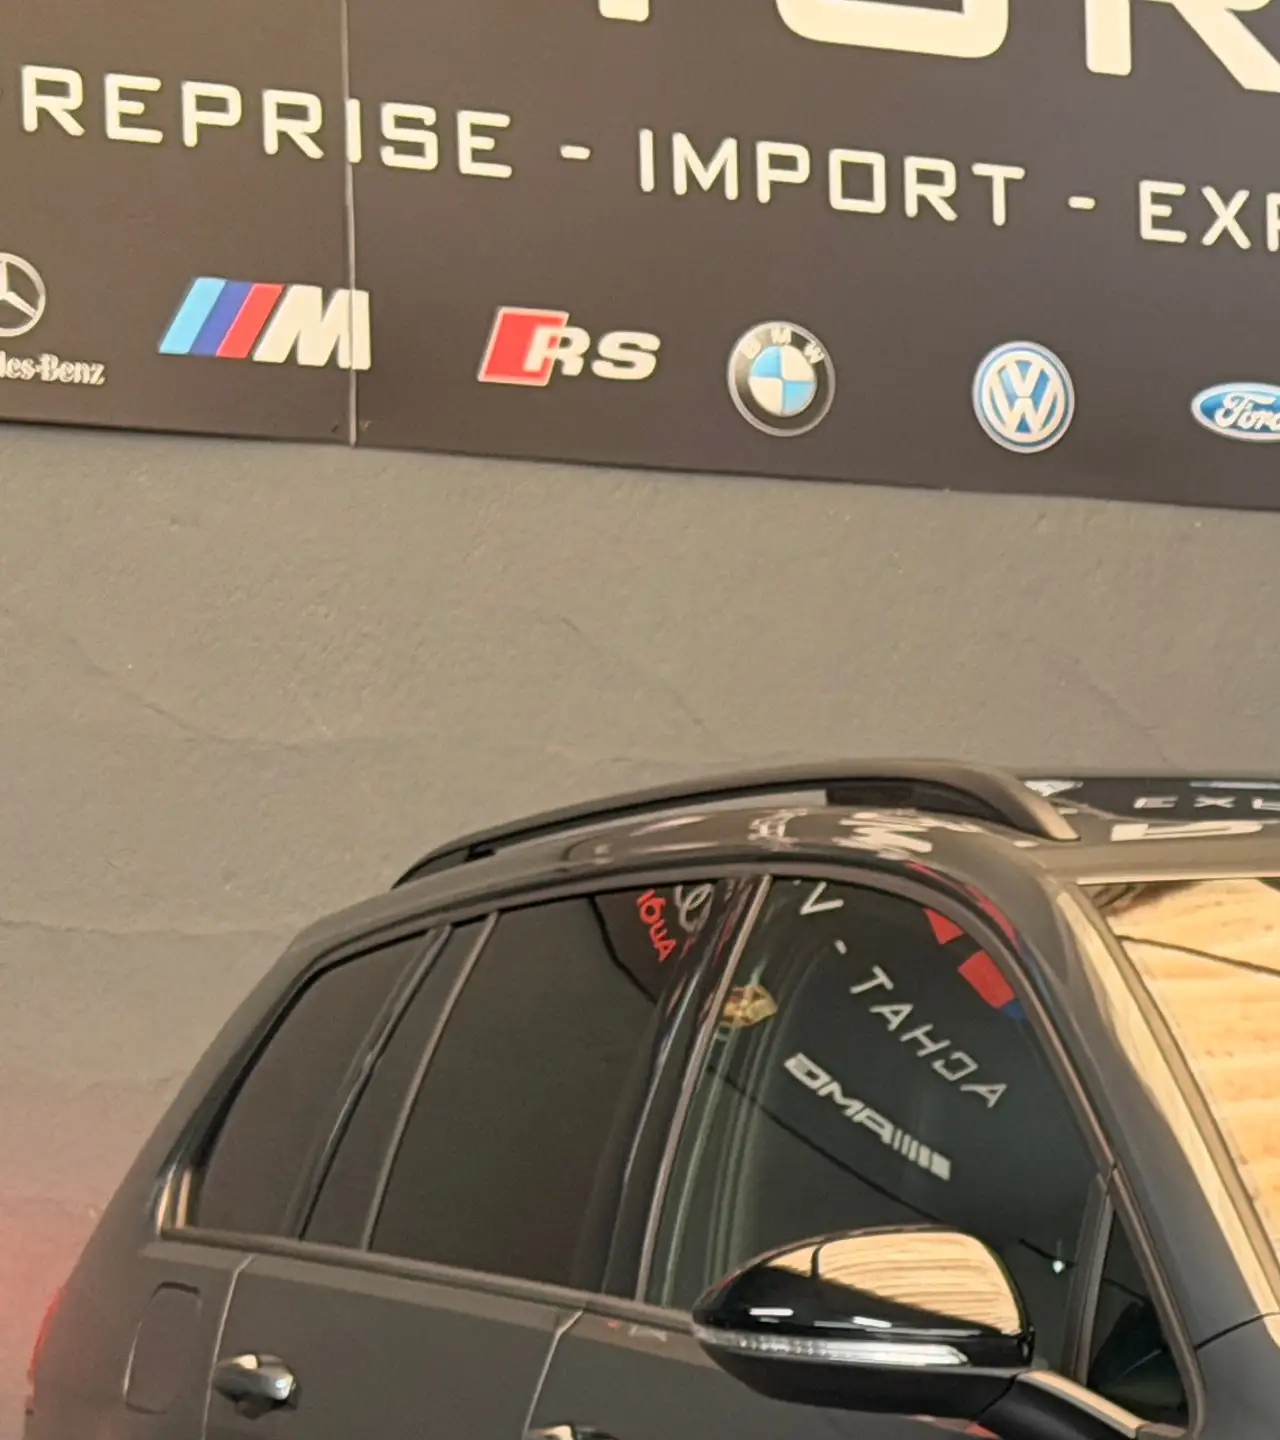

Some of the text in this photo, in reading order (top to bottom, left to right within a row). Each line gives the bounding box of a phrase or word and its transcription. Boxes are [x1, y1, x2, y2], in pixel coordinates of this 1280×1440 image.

[20, 64, 513, 178] REPRISE
[638, 128, 1026, 226] IMPORT
[524, 326, 662, 380] RS
[738, 326, 827, 365] BMW
